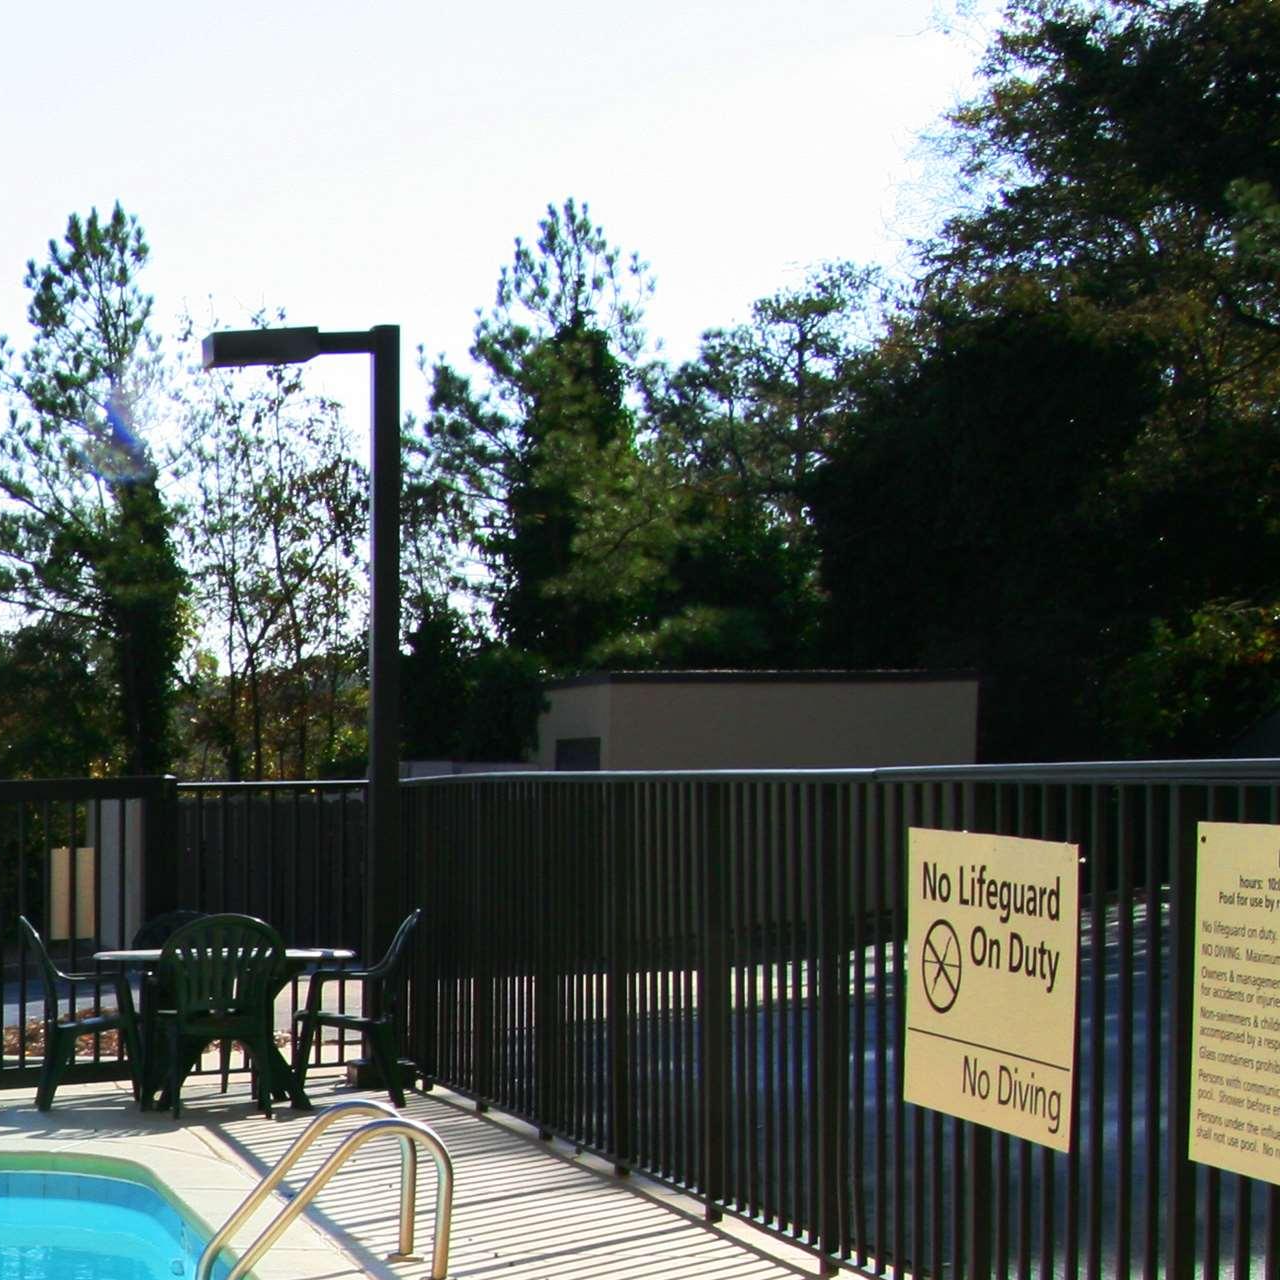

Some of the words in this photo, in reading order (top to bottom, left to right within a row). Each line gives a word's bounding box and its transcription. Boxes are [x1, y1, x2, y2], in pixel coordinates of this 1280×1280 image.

[923, 861, 951, 902] No
[959, 865, 1060, 924] Lifeguard
[1219, 891, 1235, 905] Pool
[1236, 892, 1248, 906] for
[1249, 896, 1263, 908] use
[1265, 895, 1275, 912] by
[1202, 920, 1212, 934] No
[1214, 921, 1246, 938] lifeguard
[1247, 928, 1257, 938] on
[970, 925, 1001, 969] On
[1009, 932, 1060, 993] Duty
[1201, 944, 1213, 957] NO
[1201, 966, 1228, 982] Owners
[1229, 970, 1234, 983] &
[1200, 983, 1211, 997] for
[1213, 987, 1244, 1002] accidents
[1246, 993, 1255, 1003] or
[1200, 1006, 1251, 1027] Non-swimmers
[1253, 1016, 1258, 1028] &
[1200, 1026, 1245, 1043] accompanied
[1247, 1032, 1256, 1048] by
[1257, 1037, 1262, 1046] a
[1199, 1046, 1216, 1061] Glass
[1217, 1052, 1254, 1069] containers
[1198, 1068, 1224, 1085] Persons
[1226, 1075, 1241, 1088] with
[962, 1055, 990, 1100] No
[998, 1064, 1061, 1134] Diving
[1219, 1091, 1245, 1107] Shower
[1246, 1097, 1271, 1114] before
[1197, 1108, 1223, 1126] Persons
[1224, 1117, 1245, 1131] under
[1246, 1120, 1259, 1135] the
[1196, 1126, 1212, 1139] shall
[1213, 1132, 1226, 1144] not
[1227, 1137, 1239, 1147] use
[1263, 1142, 1274, 1156] No
